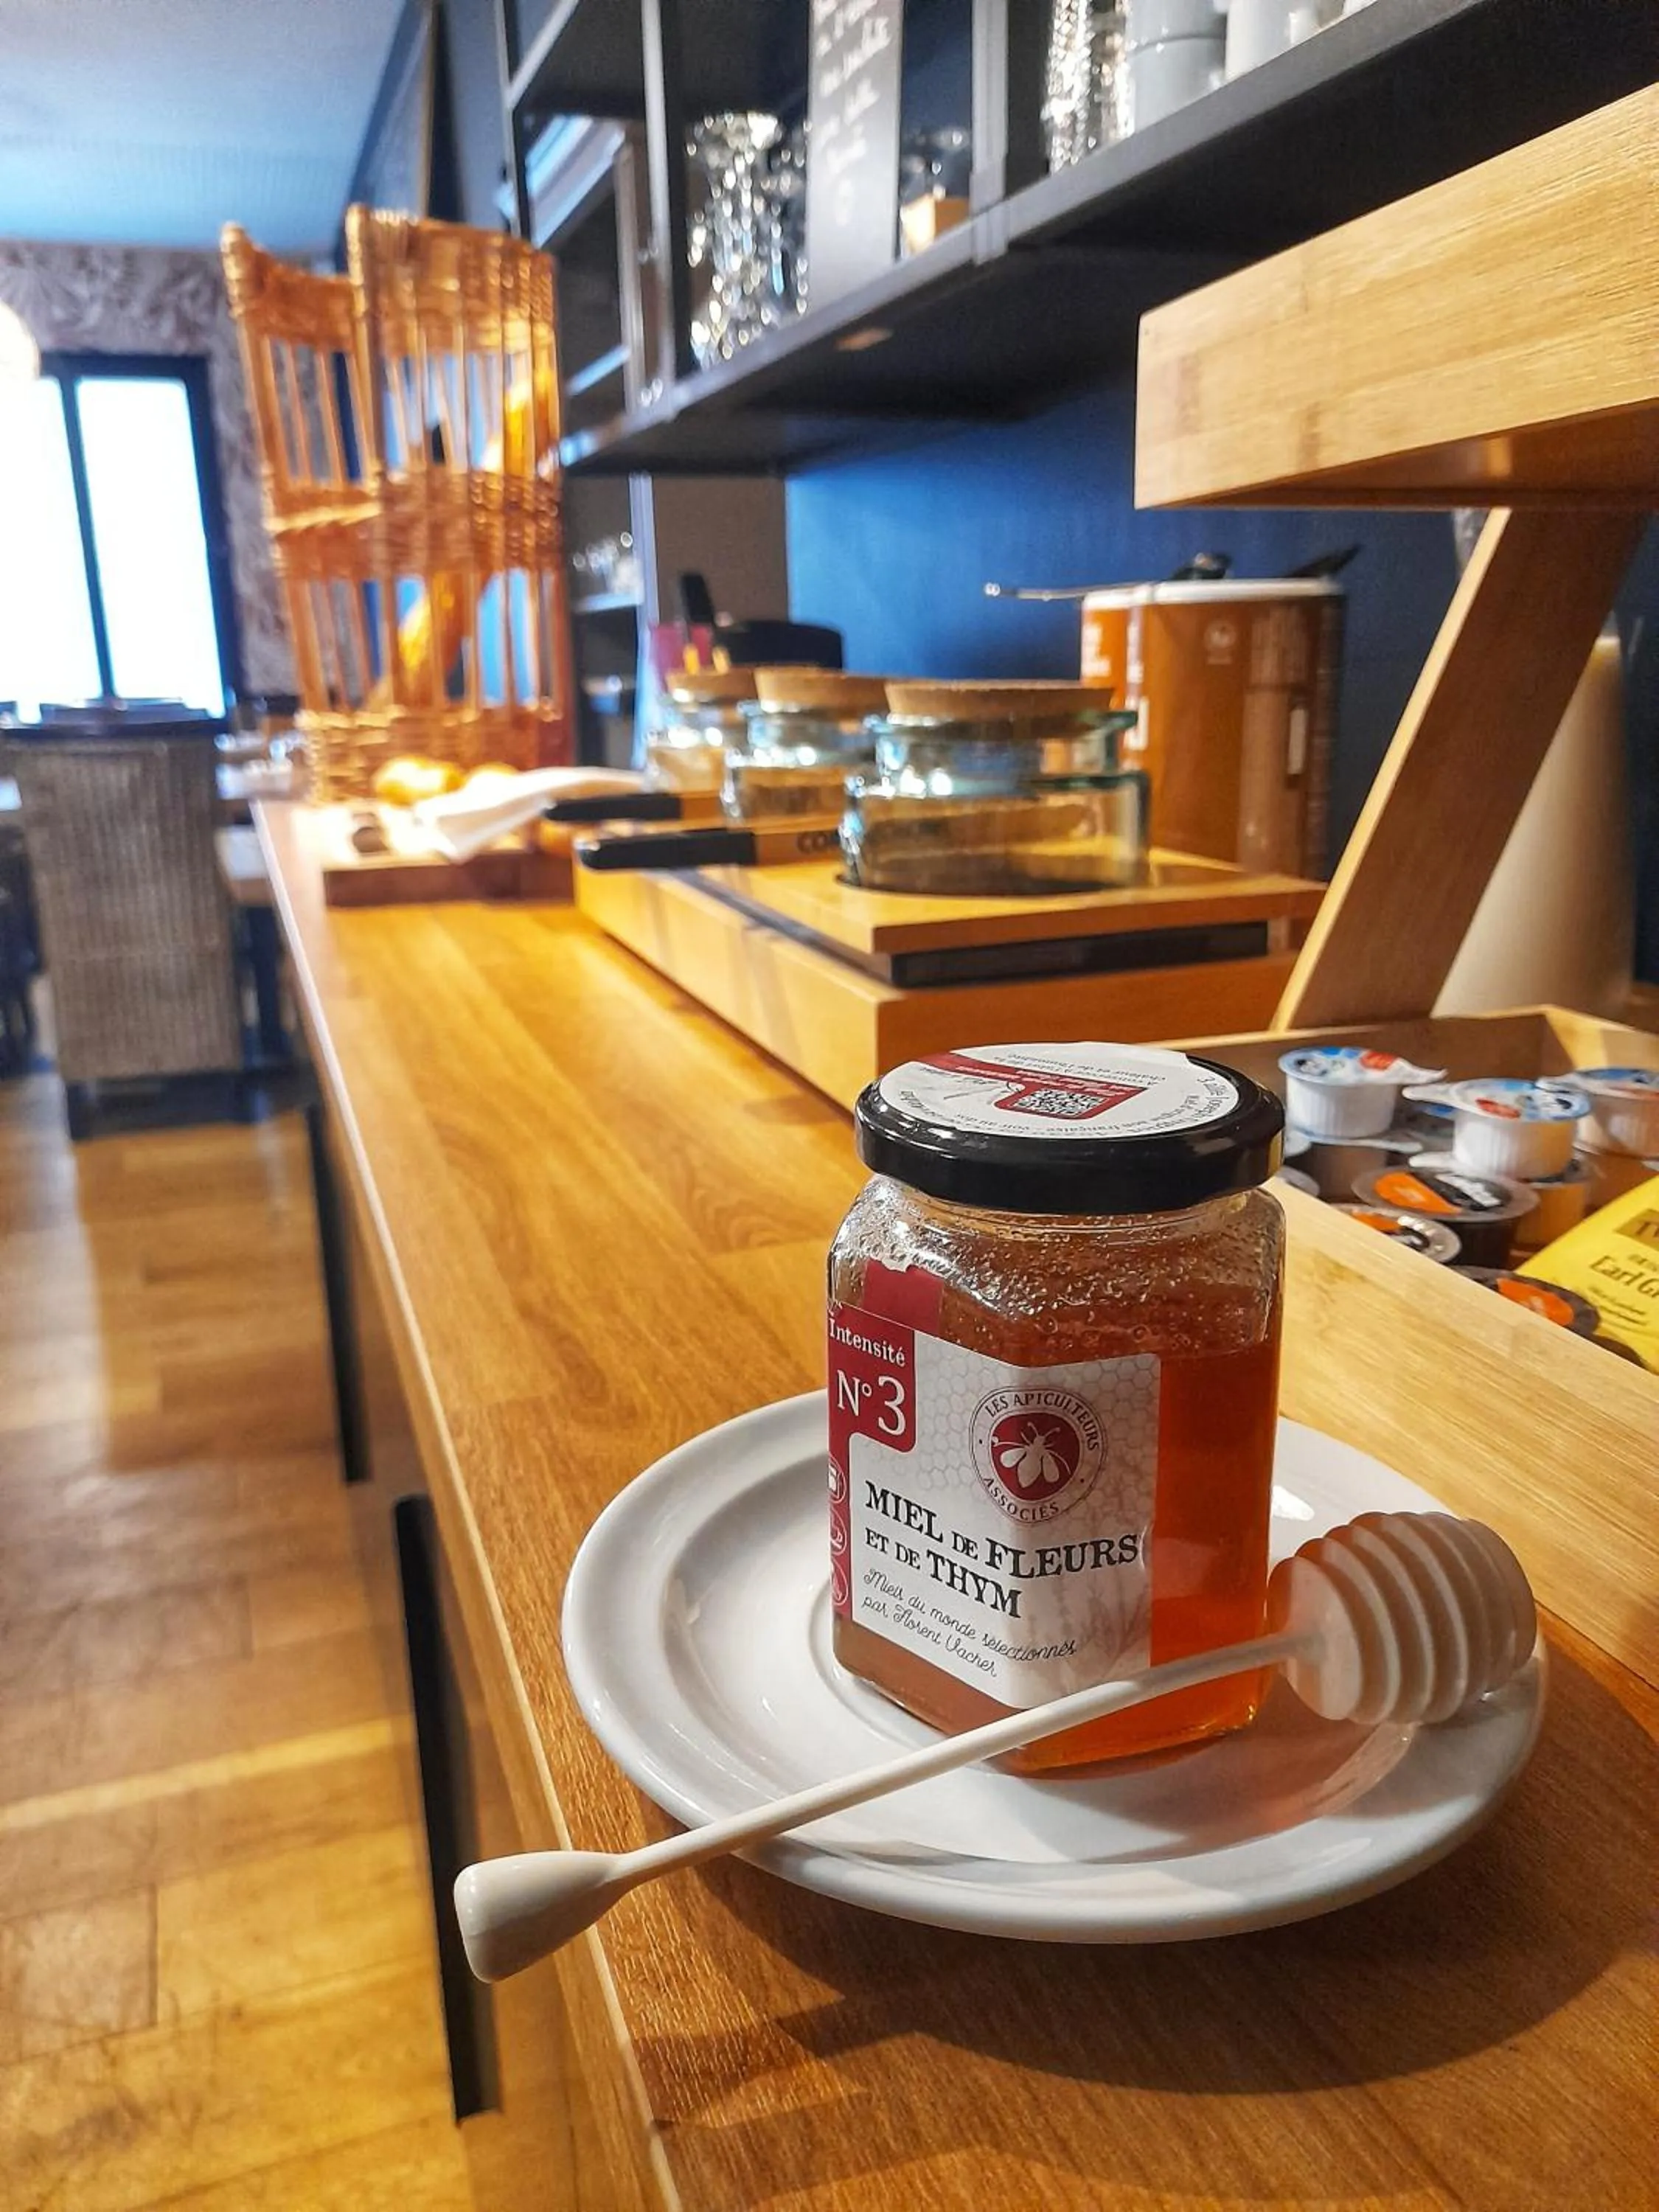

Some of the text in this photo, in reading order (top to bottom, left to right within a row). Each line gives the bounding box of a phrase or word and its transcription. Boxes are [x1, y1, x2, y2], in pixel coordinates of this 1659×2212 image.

[1590, 1255, 1645, 1287] Earl
[829, 1318, 907, 1368] Intensité
[878, 1374, 907, 1436] 3
[984, 1392, 1100, 1451] LES APICULTEURS
[865, 1480, 1139, 1579] MIEL DE FLEURS
[863, 1568, 904, 1601] Miels
[907, 1596, 926, 1615] du
[930, 1607, 978, 1641] monde
[864, 1527, 1023, 1619] ET DE THYM
[860, 1596, 998, 1678] par Florent Vacher
